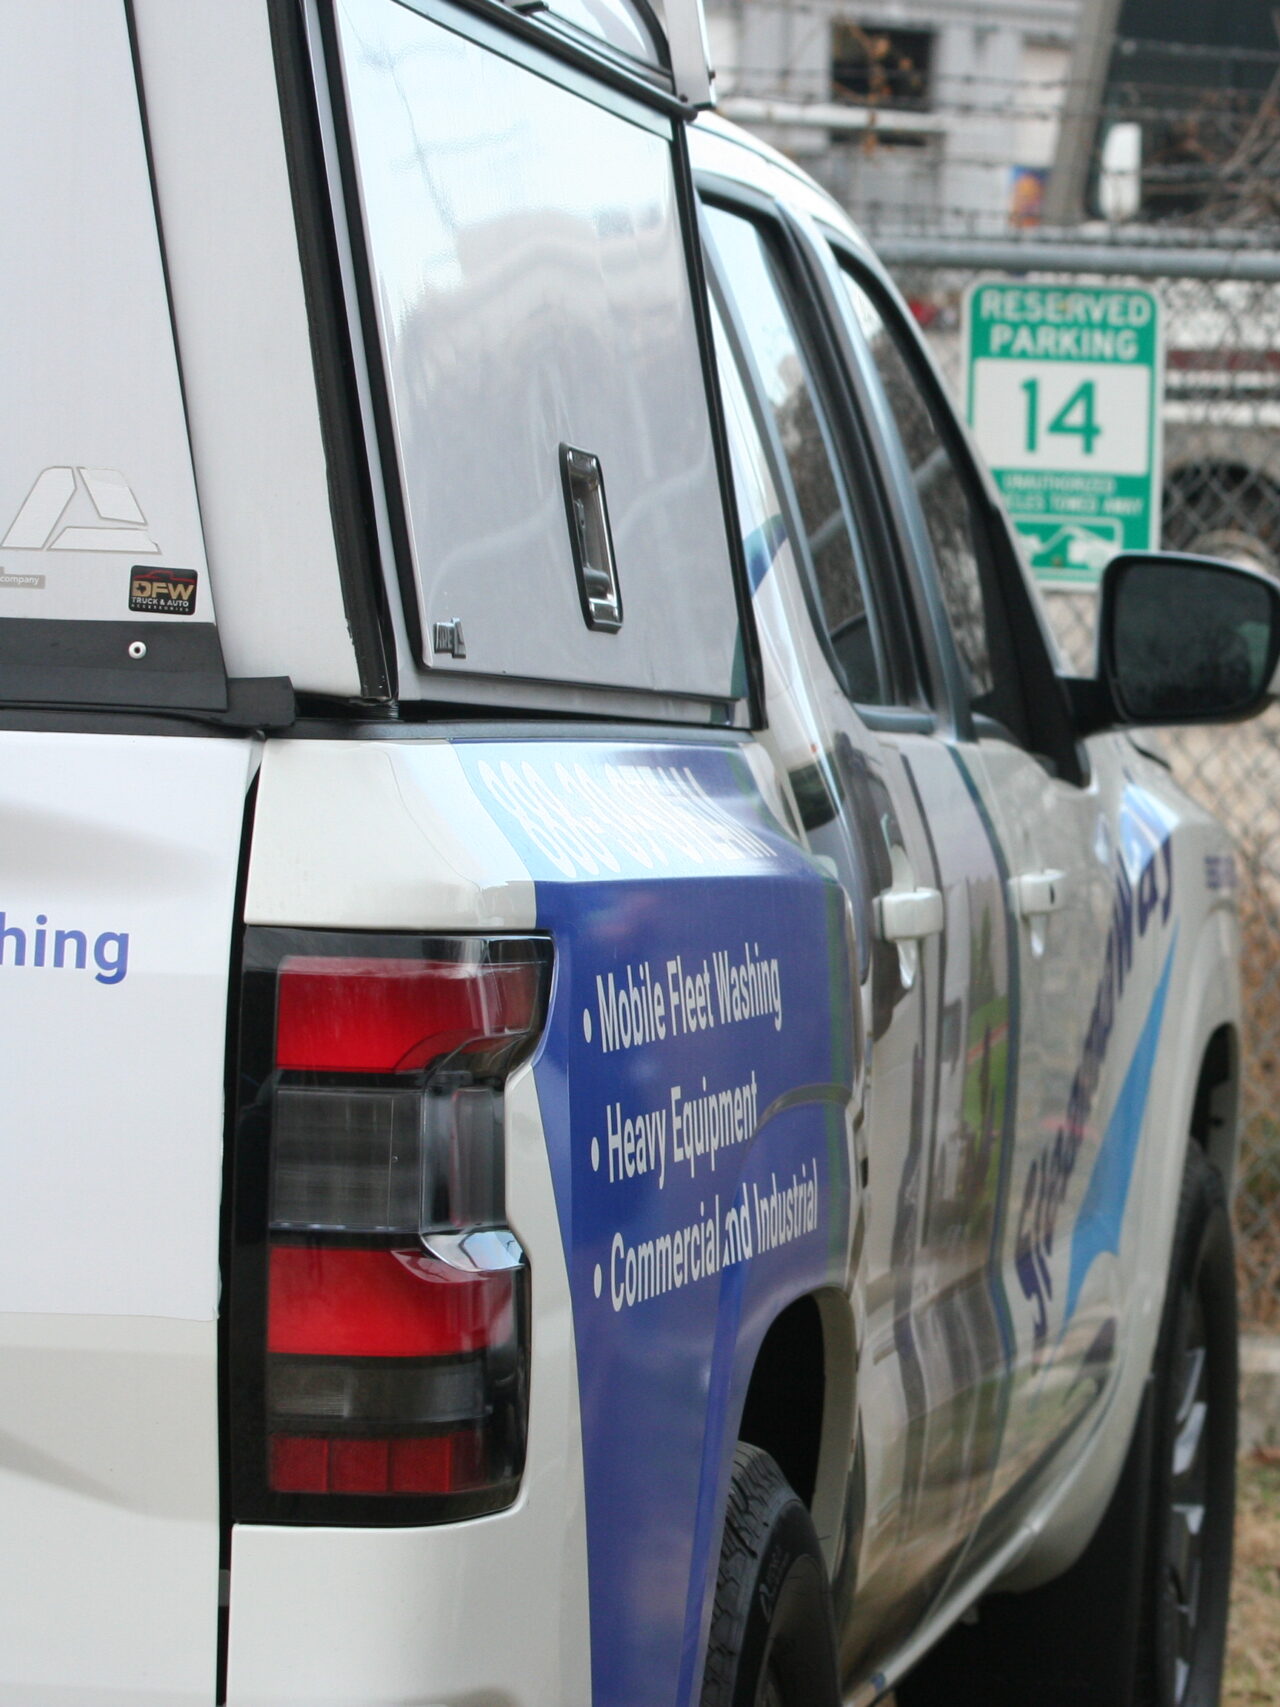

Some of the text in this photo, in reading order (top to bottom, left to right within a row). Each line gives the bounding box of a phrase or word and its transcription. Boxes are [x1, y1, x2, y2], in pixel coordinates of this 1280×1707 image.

[980, 288, 1152, 327] RESERVED
[989, 324, 1139, 361] PARKING
[1021, 378, 1101, 455] 14
[1003, 472, 1116, 493] UNAUTHORIZED
[131, 580, 194, 600] DFW
[131, 597, 158, 605] TRUCK
[596, 942, 782, 1053] Mobile Fleet Washing
[606, 1070, 758, 1190] Heavy Equipment
[610, 1194, 721, 1312] Commercial
[752, 1158, 818, 1255] Industrial
